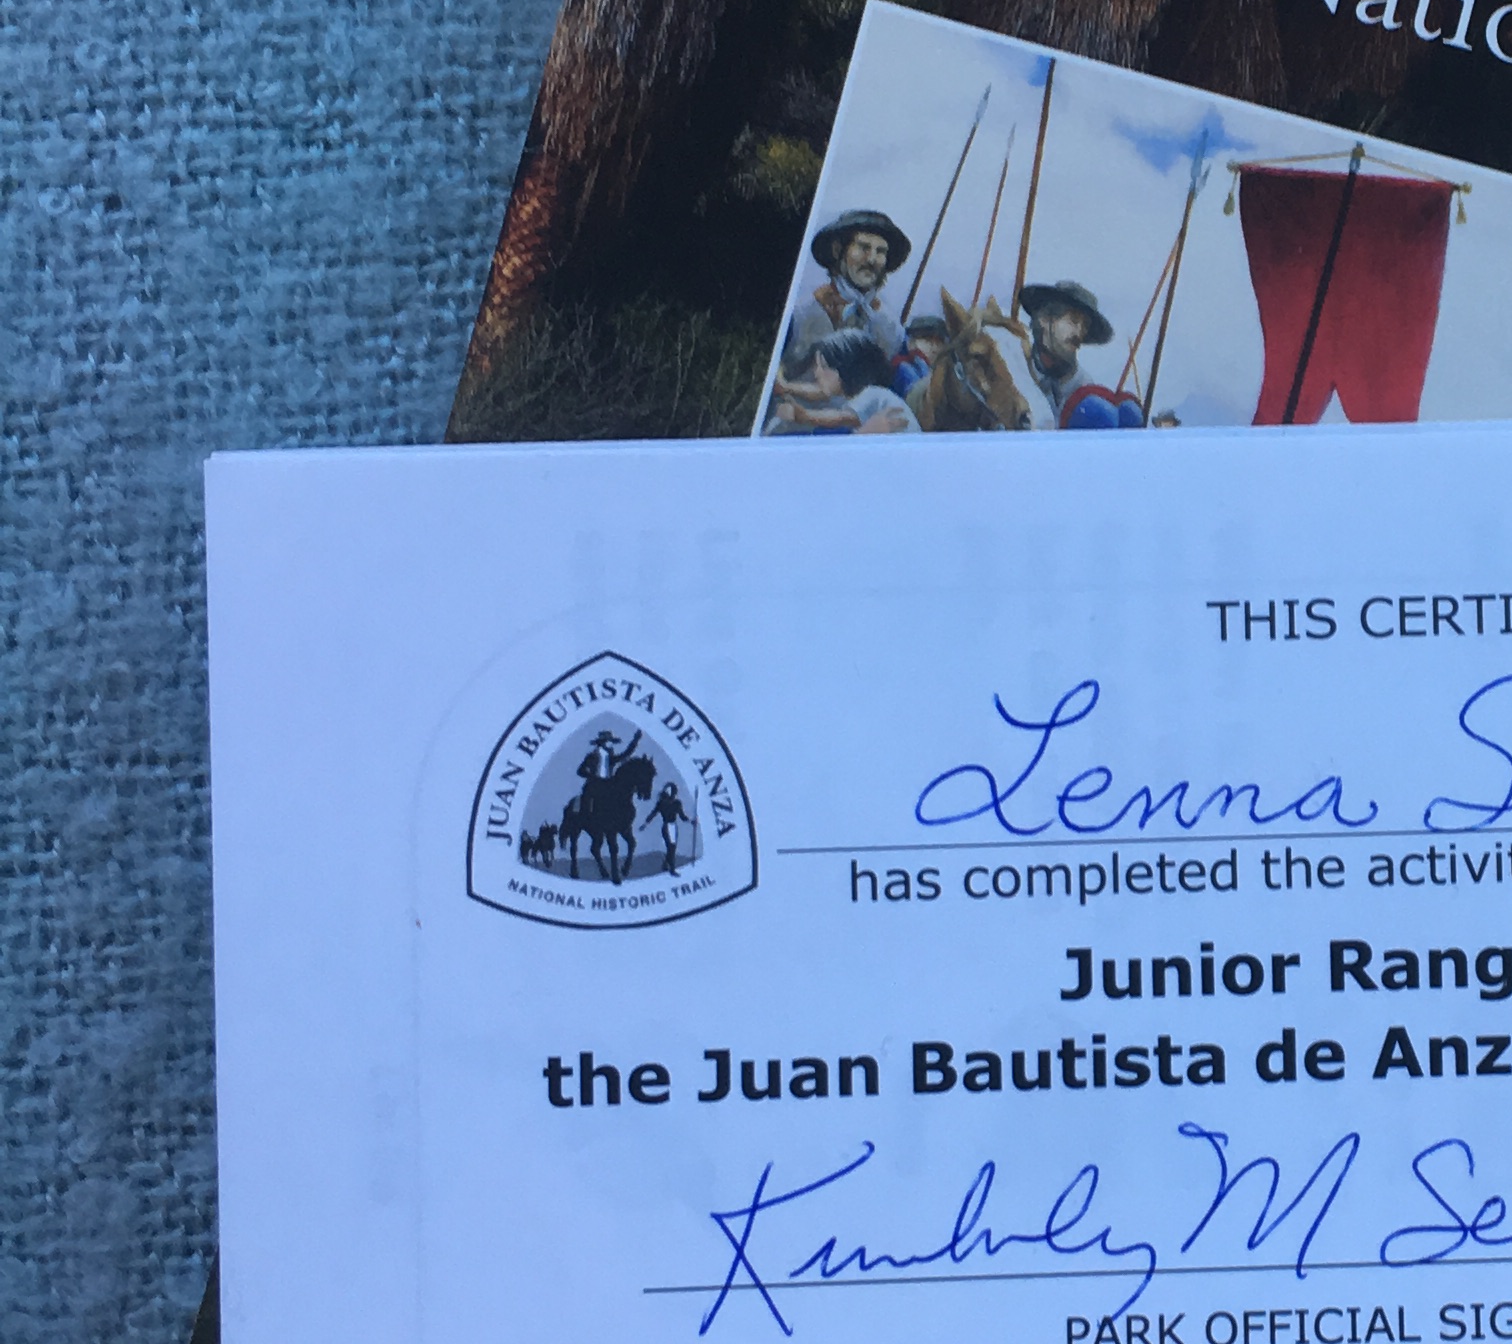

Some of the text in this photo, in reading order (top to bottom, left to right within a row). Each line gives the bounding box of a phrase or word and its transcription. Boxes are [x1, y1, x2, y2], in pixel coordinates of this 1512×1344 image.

[1204, 596, 1338, 644] THIS
[486, 677, 737, 847] JUAN BAUTISTA DE ANZA
[507, 874, 716, 912] NATIONAL HISTORIC TRAIL
[849, 857, 943, 905] has
[962, 846, 1239, 908] completed
[1259, 845, 1347, 892] the
[1058, 940, 1302, 1003] Junior
[541, 1050, 672, 1110] the
[696, 1047, 881, 1105] Juan
[910, 1032, 1227, 1096] Bautista
[1254, 1026, 1347, 1085] de
[1178, 1121, 1360, 1280] M
